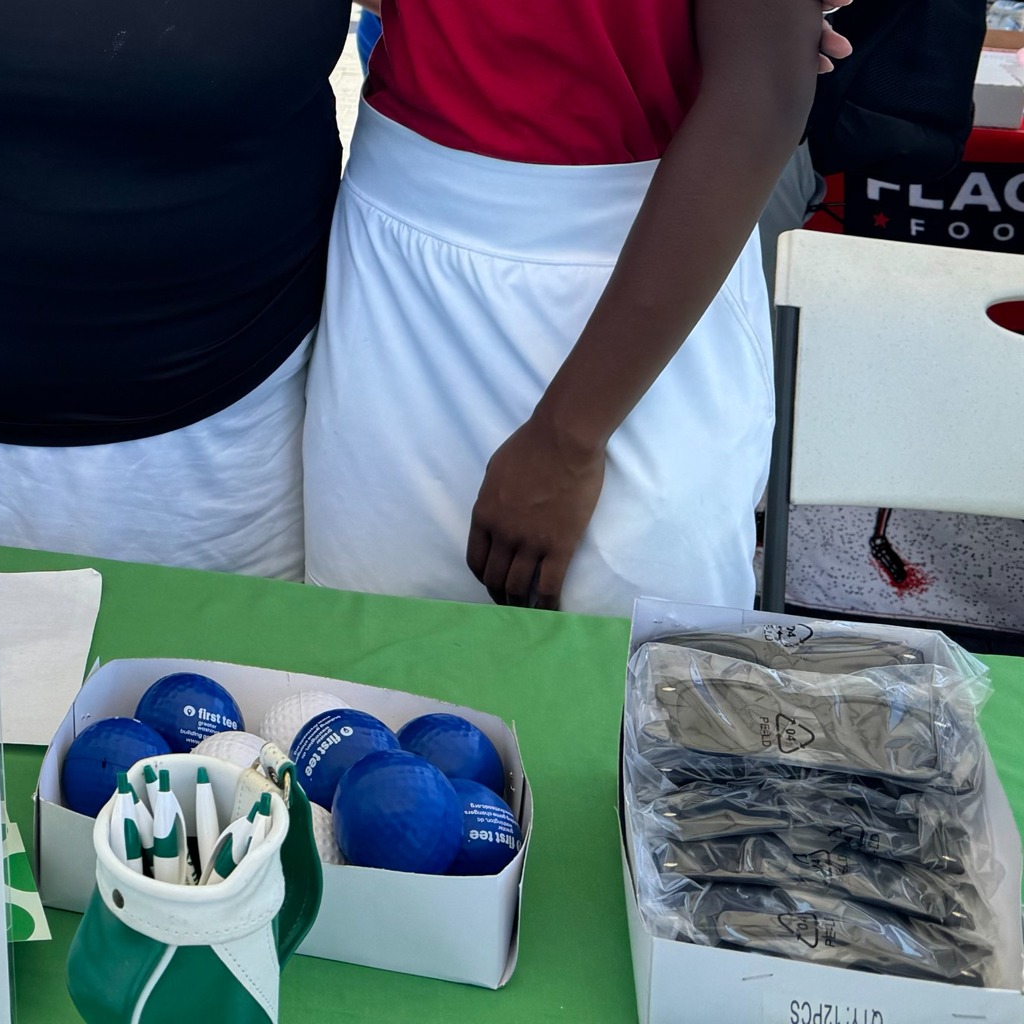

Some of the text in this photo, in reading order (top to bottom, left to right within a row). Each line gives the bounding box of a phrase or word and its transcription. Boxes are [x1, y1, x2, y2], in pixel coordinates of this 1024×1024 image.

[198, 707, 238, 730] first tee
[317, 732, 342, 755] first
[304, 752, 321, 777] tee
[469, 829, 515, 850] first tee
